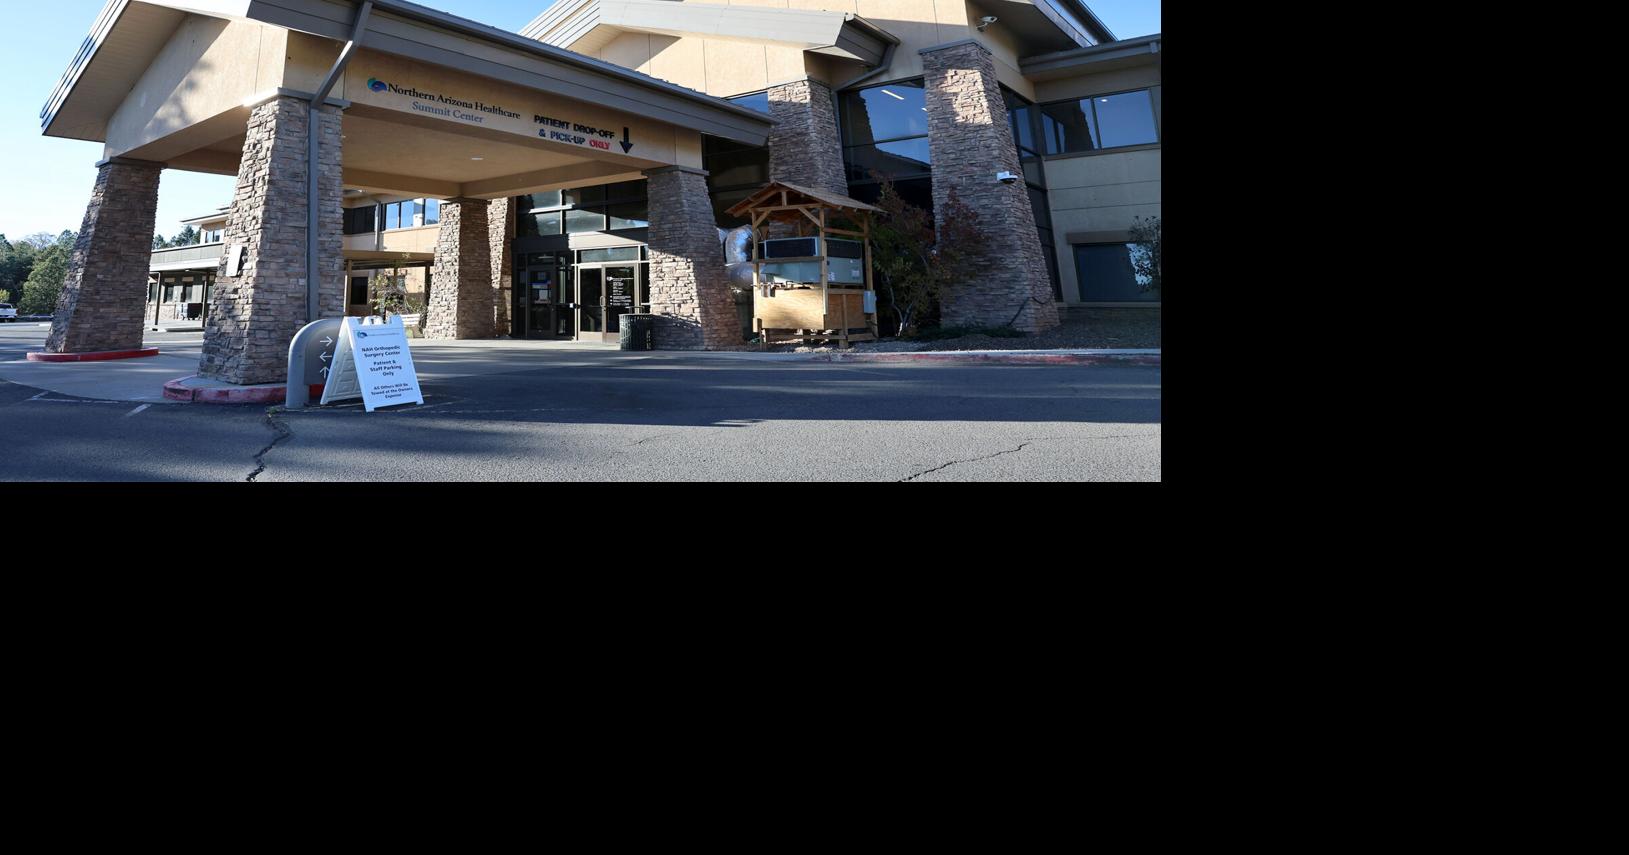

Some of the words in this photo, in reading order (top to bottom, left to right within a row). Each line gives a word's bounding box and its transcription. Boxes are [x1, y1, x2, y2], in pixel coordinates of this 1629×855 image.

[388, 83, 435, 102] Northern
[437, 93, 473, 110] Arizona
[475, 102, 521, 120] Healthcare
[412, 101, 450, 117] Summit
[453, 109, 484, 123] Center
[534, 114, 570, 130] PATIENT
[573, 123, 615, 139] DROP-OFF
[538, 128, 546, 138] &
[550, 130, 585, 145] PICK-UP
[589, 139, 611, 150] ONLY
